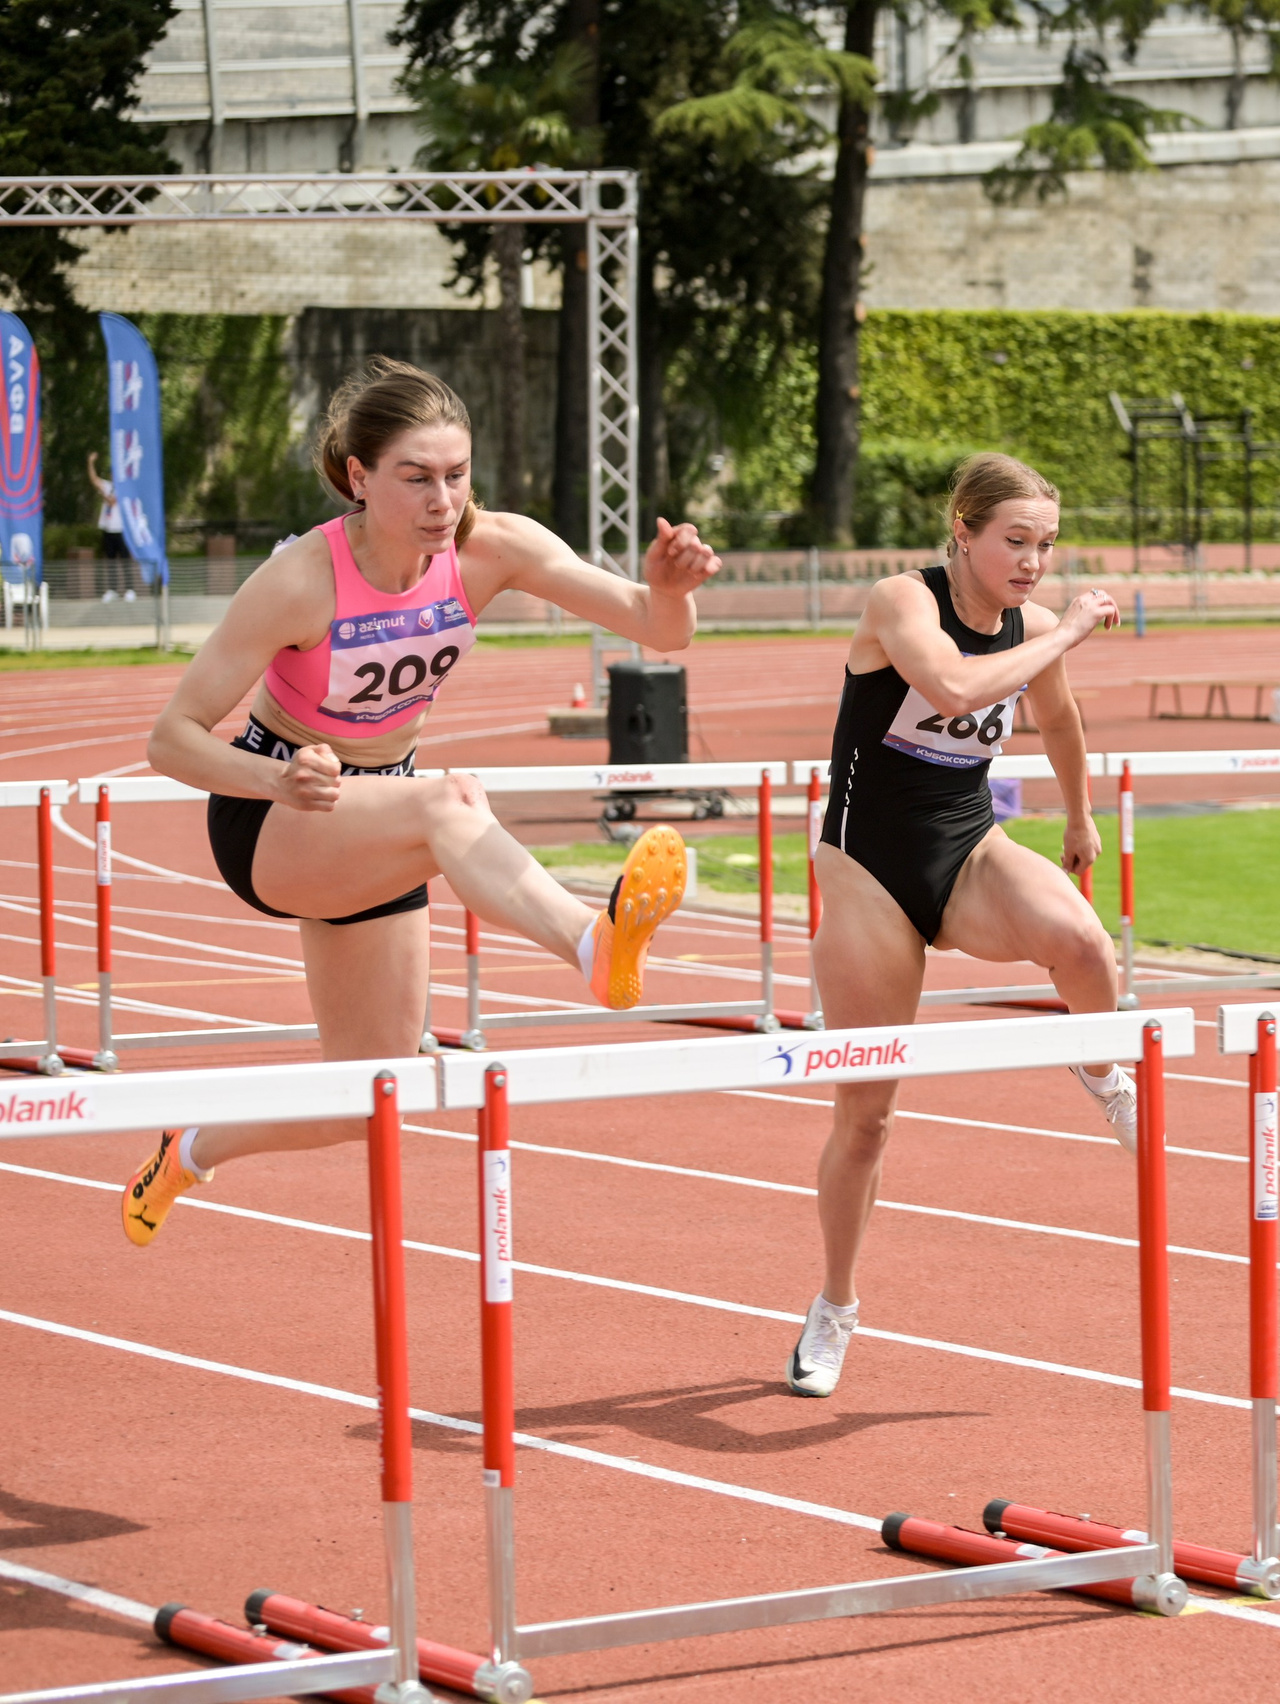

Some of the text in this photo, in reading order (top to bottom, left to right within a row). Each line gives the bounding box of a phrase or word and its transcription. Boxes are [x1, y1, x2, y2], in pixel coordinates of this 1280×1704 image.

[359, 615, 405, 633] azimut
[348, 645, 460, 704] 209
[916, 748, 953, 763] КУБОК
[804, 1037, 909, 1077] polanik
[1261, 1126, 1277, 1195] polanik
[491, 1187, 510, 1262] polanik
